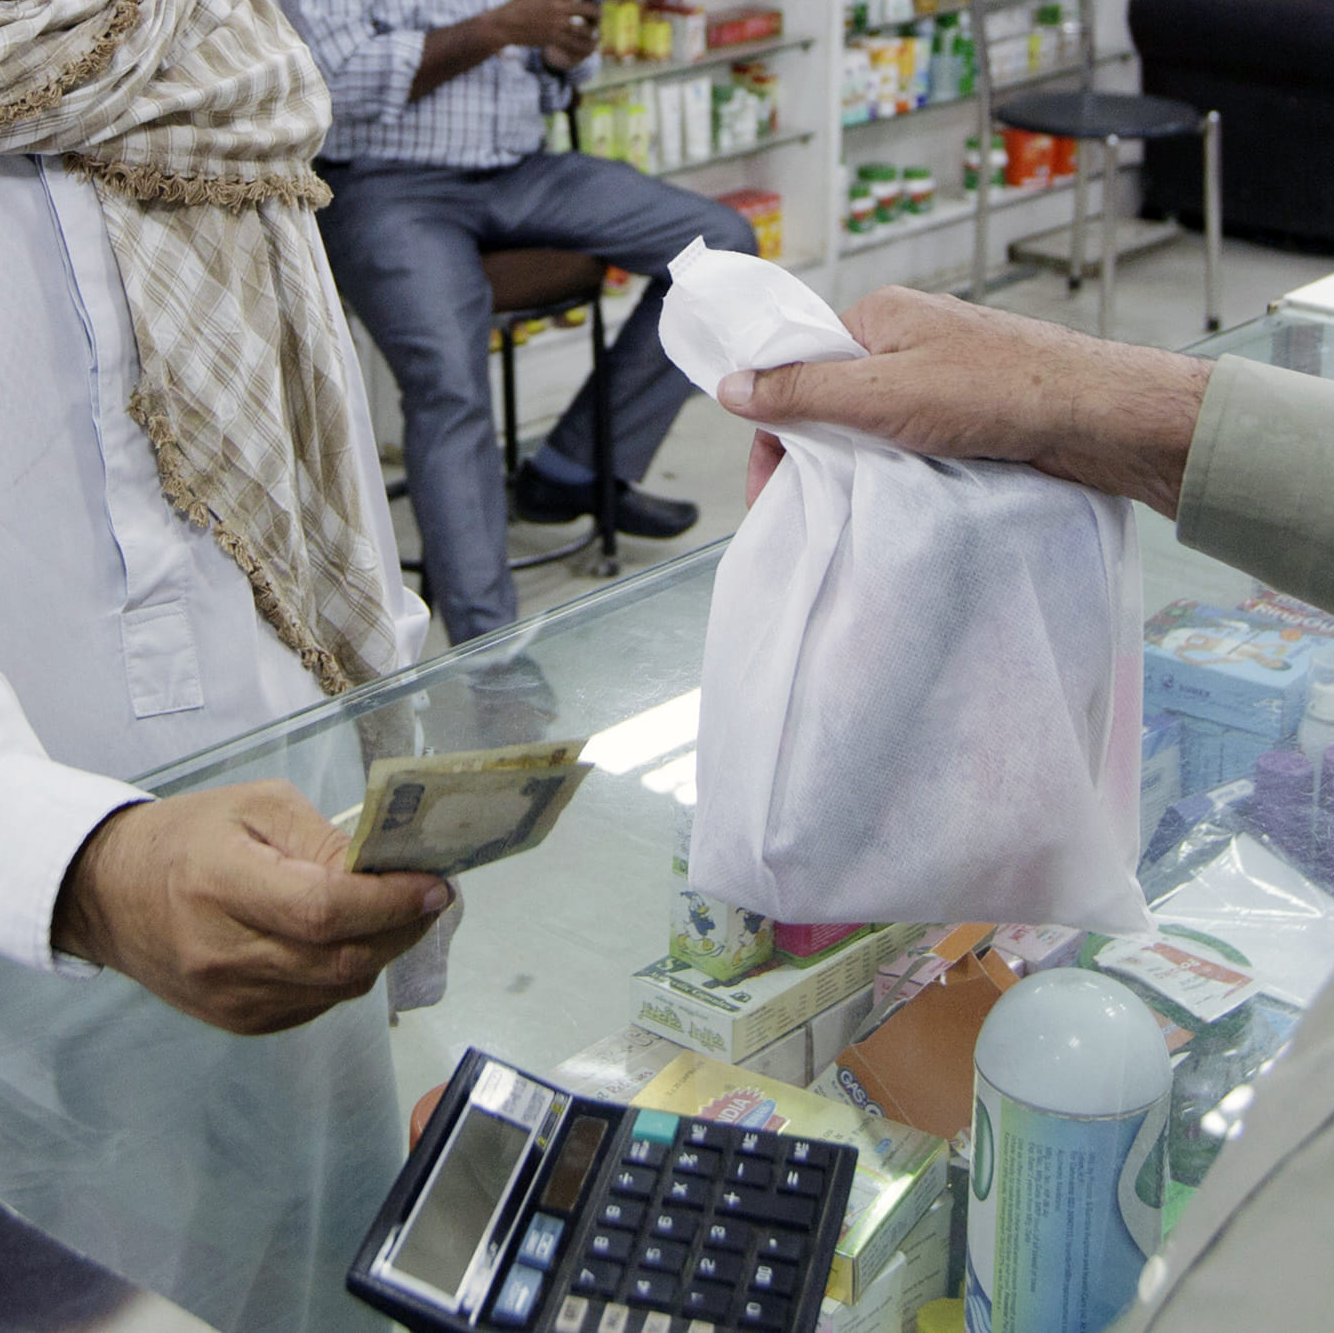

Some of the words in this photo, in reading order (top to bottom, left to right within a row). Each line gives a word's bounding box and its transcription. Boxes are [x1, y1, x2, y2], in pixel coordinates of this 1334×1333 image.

[593, 1235, 610, 1252] 8
[605, 1204, 621, 1220] 9
[645, 1247, 662, 1263] 5
[657, 1215, 673, 1232] 6
[699, 1257, 716, 1274] 2
[709, 1225, 727, 1241] 3
[746, 1301, 762, 1316] 0
